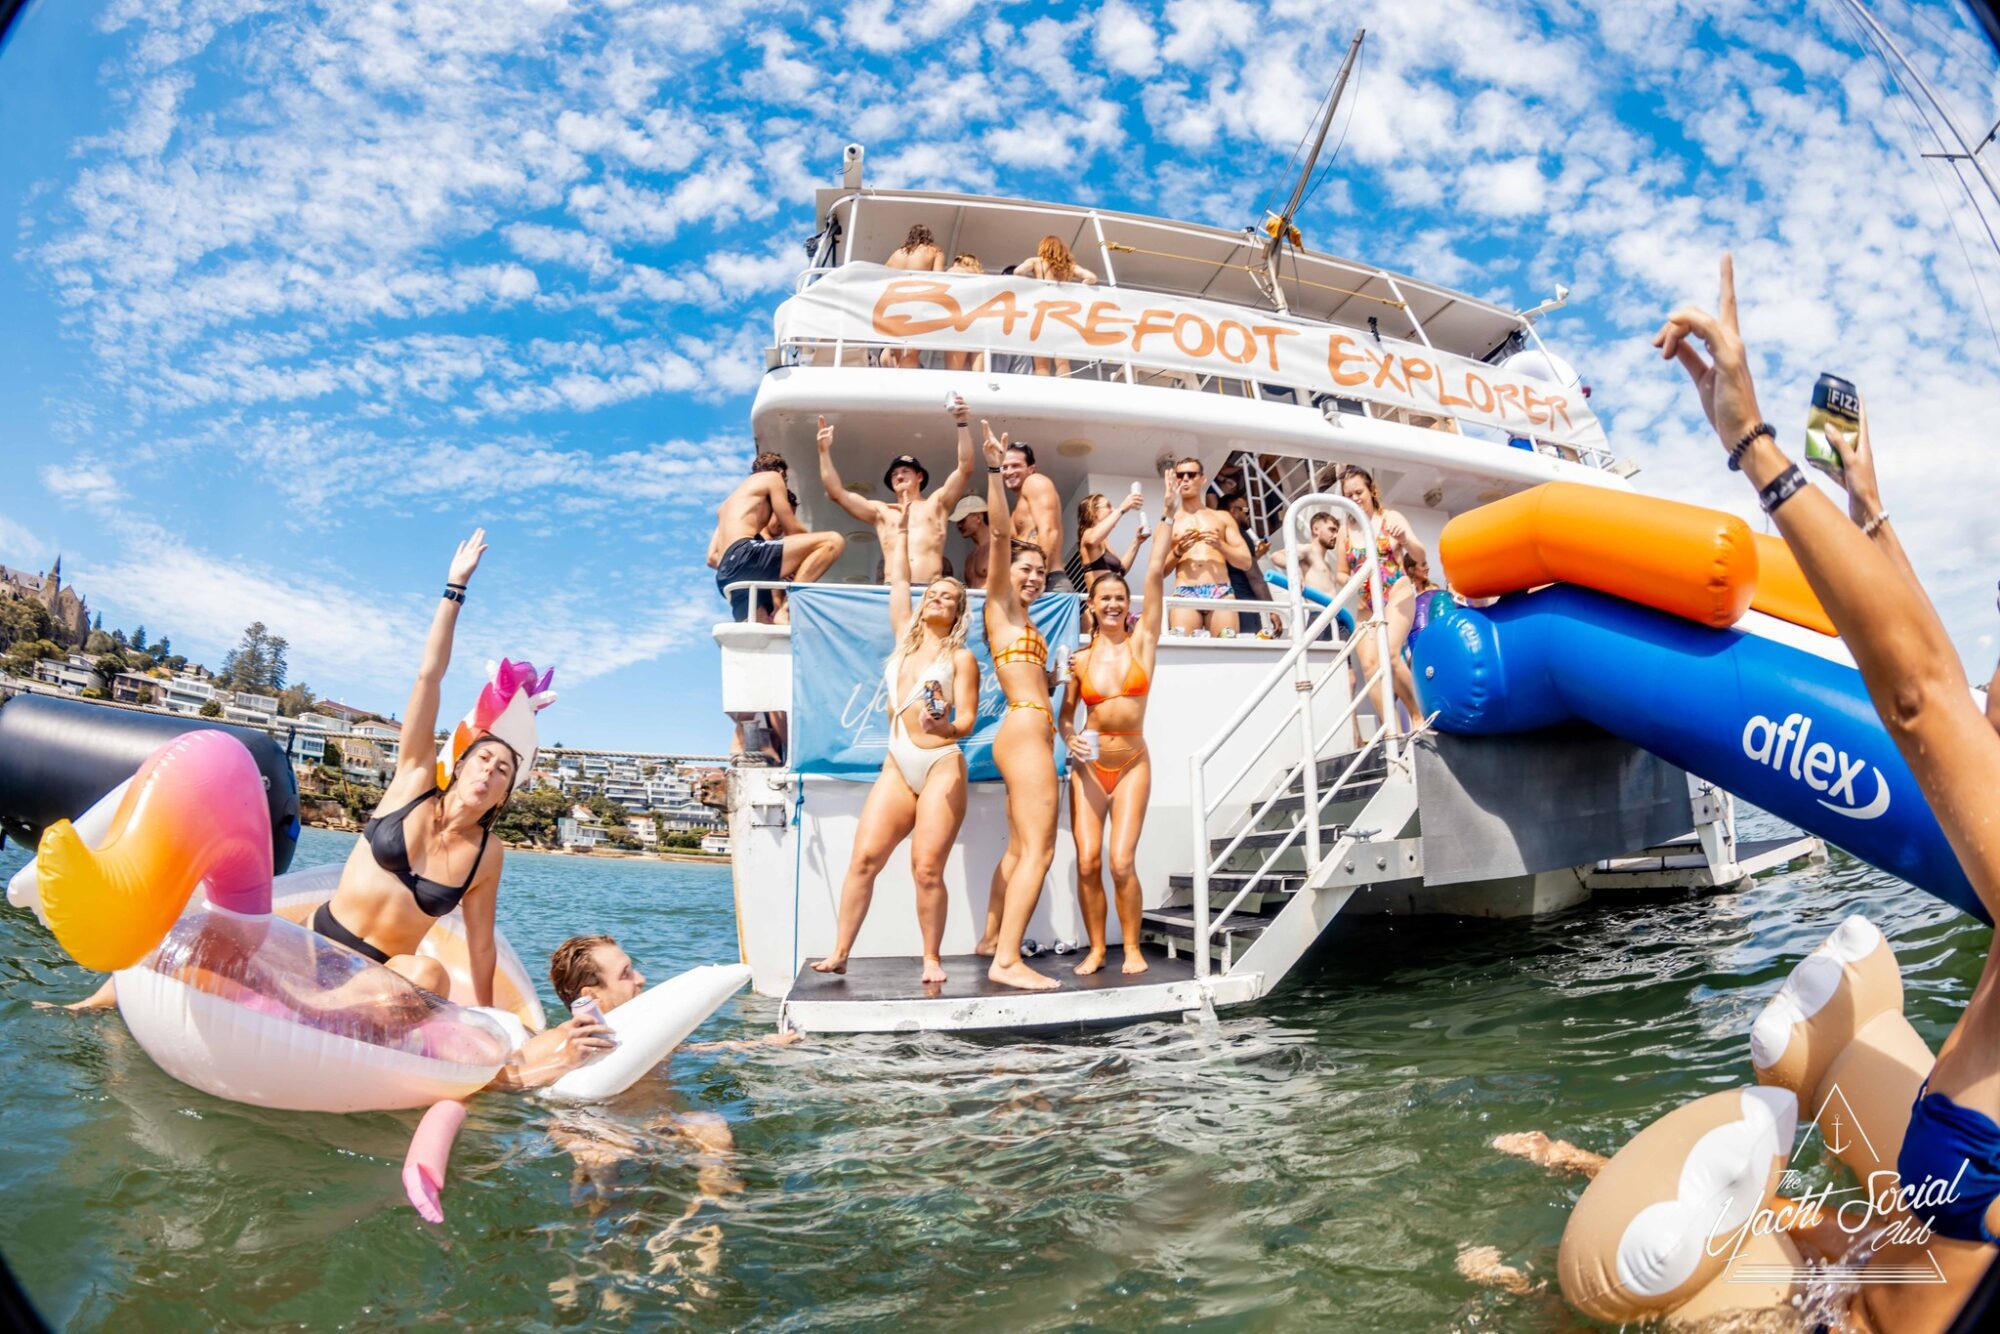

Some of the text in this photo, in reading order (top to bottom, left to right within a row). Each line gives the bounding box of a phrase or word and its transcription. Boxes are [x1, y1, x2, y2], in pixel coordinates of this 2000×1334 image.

[872, 280, 1573, 431] BAREFOOT EXPLORER
[1742, 713, 1866, 805] aflex
